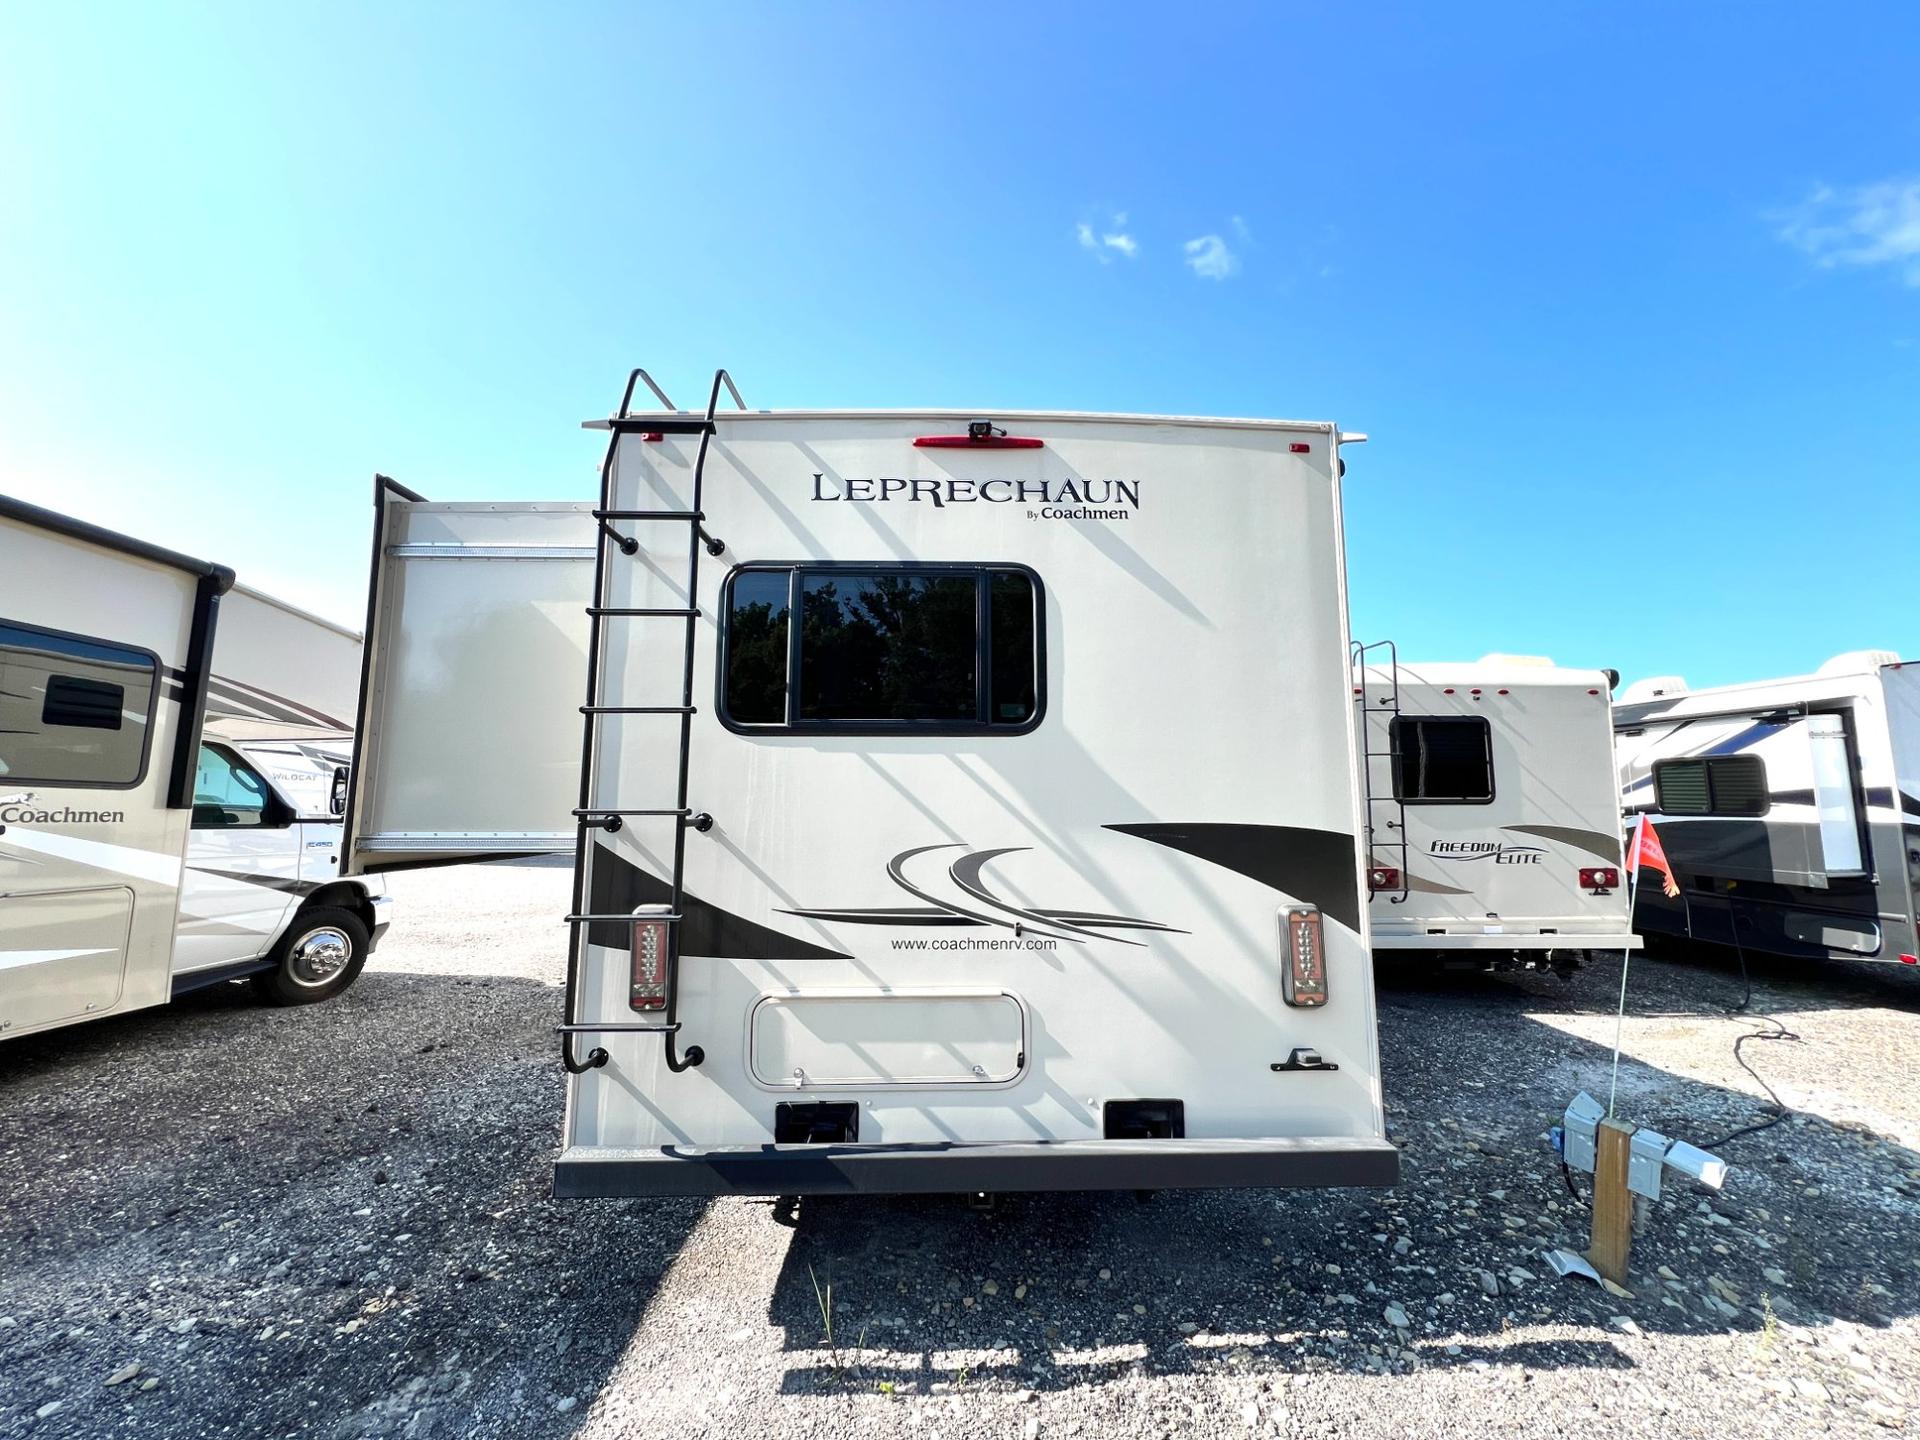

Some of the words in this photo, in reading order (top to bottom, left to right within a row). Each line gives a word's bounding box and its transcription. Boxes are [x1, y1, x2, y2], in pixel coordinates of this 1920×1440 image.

[811, 474, 1140, 509] LEPRECHAUN
[1027, 510, 1039, 521] By
[1041, 507, 1129, 520] Coachmen
[0, 806, 124, 823] Coachmen
[1430, 839, 1503, 852] FREEDOM
[1495, 852, 1543, 864] ELITE
[891, 937, 1057, 950] www.coachmenrv.com
